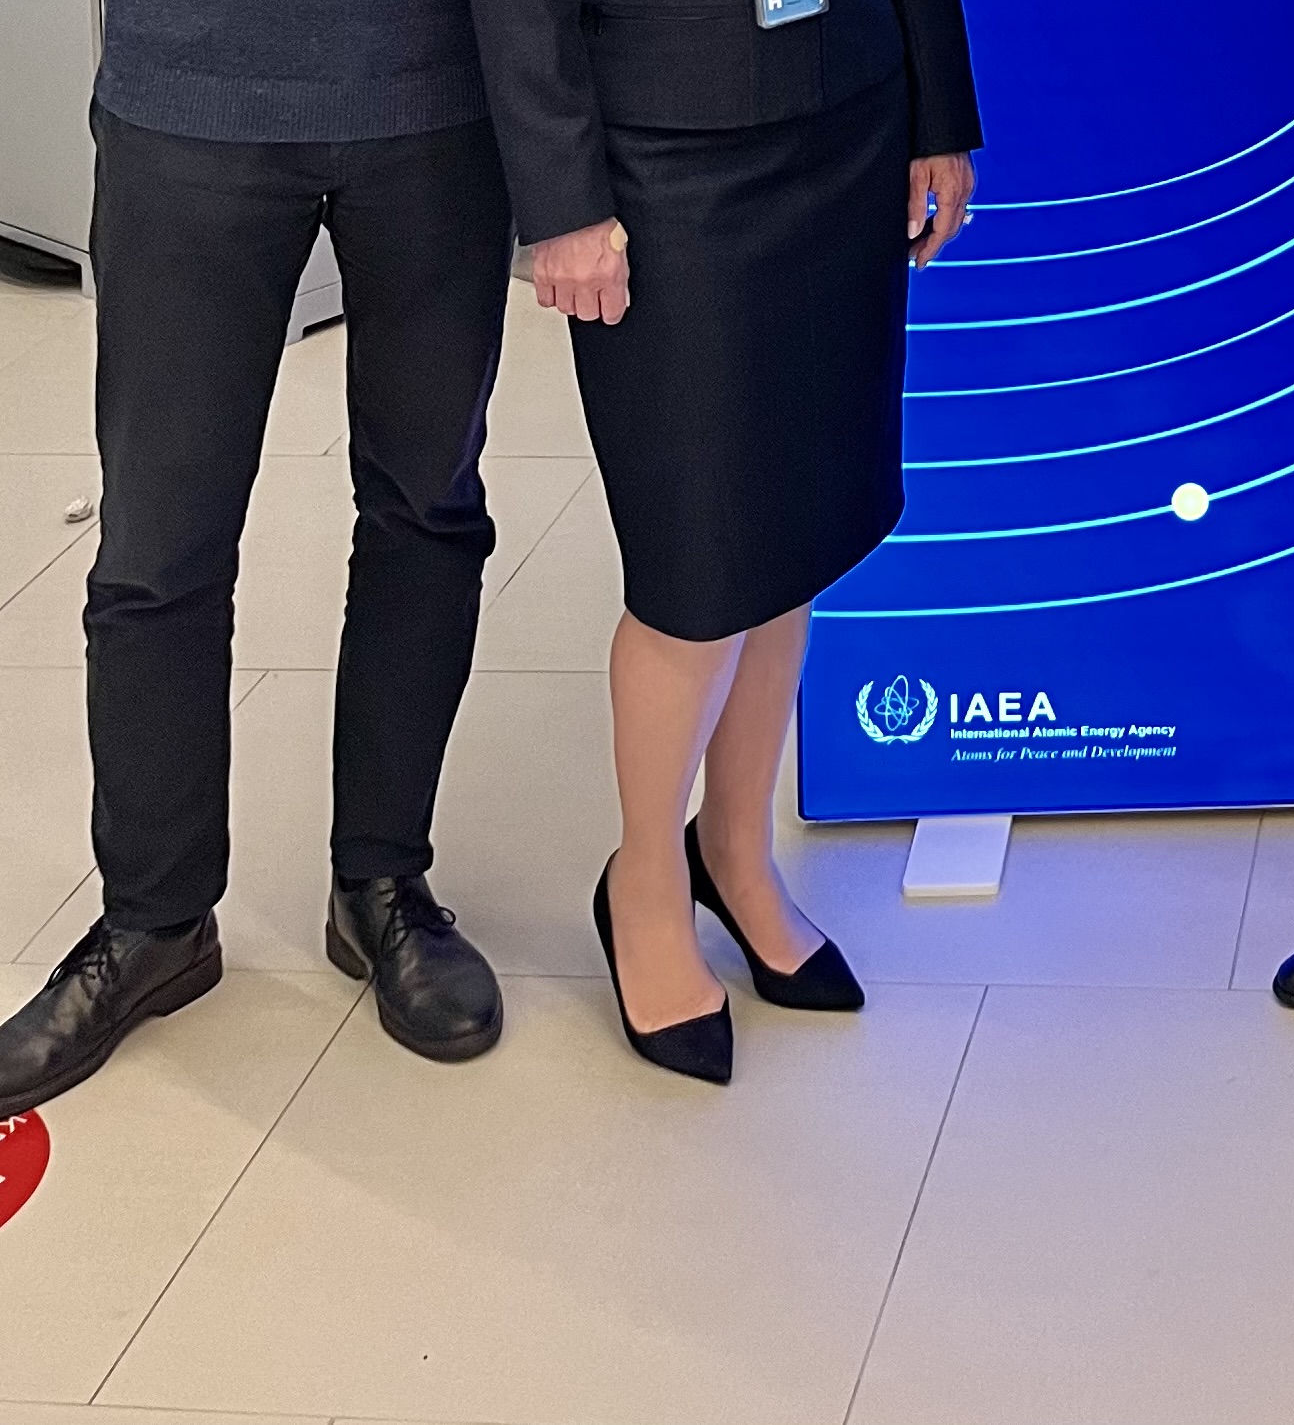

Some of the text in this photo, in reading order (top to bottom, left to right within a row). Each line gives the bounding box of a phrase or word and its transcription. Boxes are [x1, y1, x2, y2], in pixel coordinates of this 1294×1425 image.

[950, 691, 1056, 723] IAEA
[950, 724, 1176, 739] International Atomic Energy Agency
[951, 744, 1177, 763] Atoms for Peace and Development
